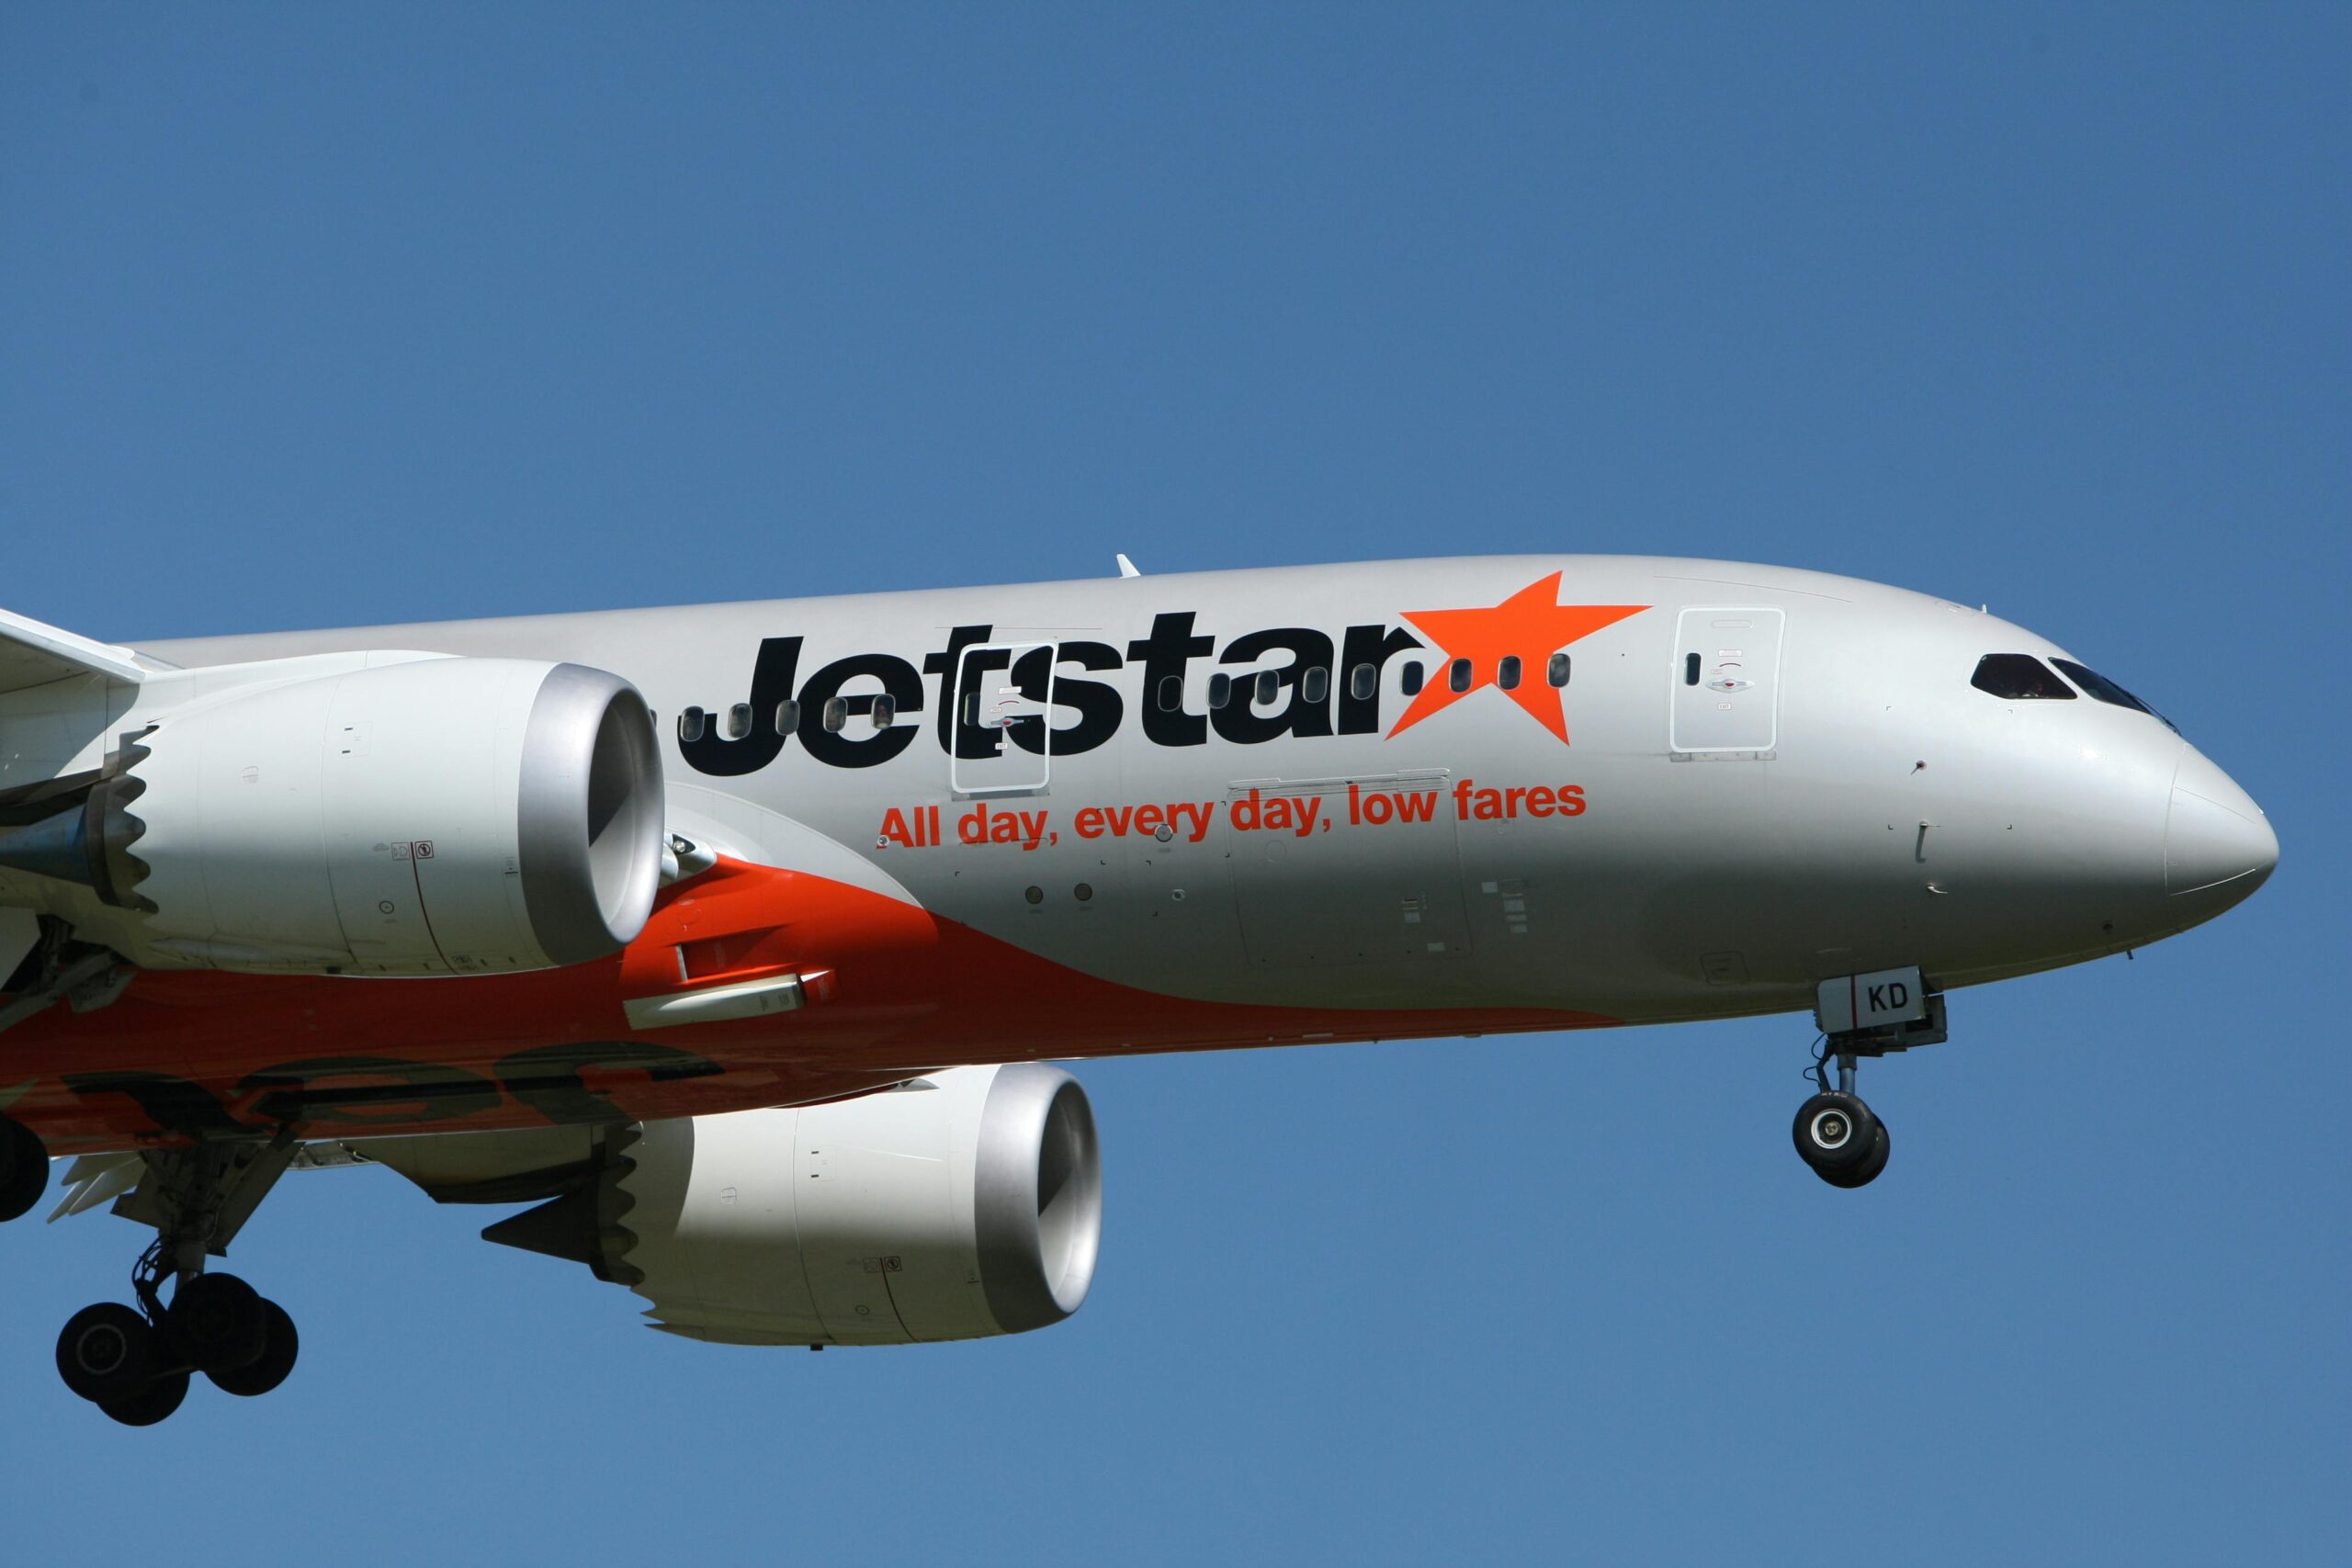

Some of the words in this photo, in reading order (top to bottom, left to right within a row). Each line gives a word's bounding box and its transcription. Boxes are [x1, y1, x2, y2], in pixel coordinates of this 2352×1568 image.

[678, 612, 1424, 776] Jetstar
[876, 805, 939, 849] All
[959, 802, 1057, 851] day,
[1076, 802, 1215, 843] every
[1231, 788, 1331, 837] day,
[1350, 784, 1437, 826] low
[1454, 779, 1586, 821] fares
[1868, 983, 1907, 1012] KD
